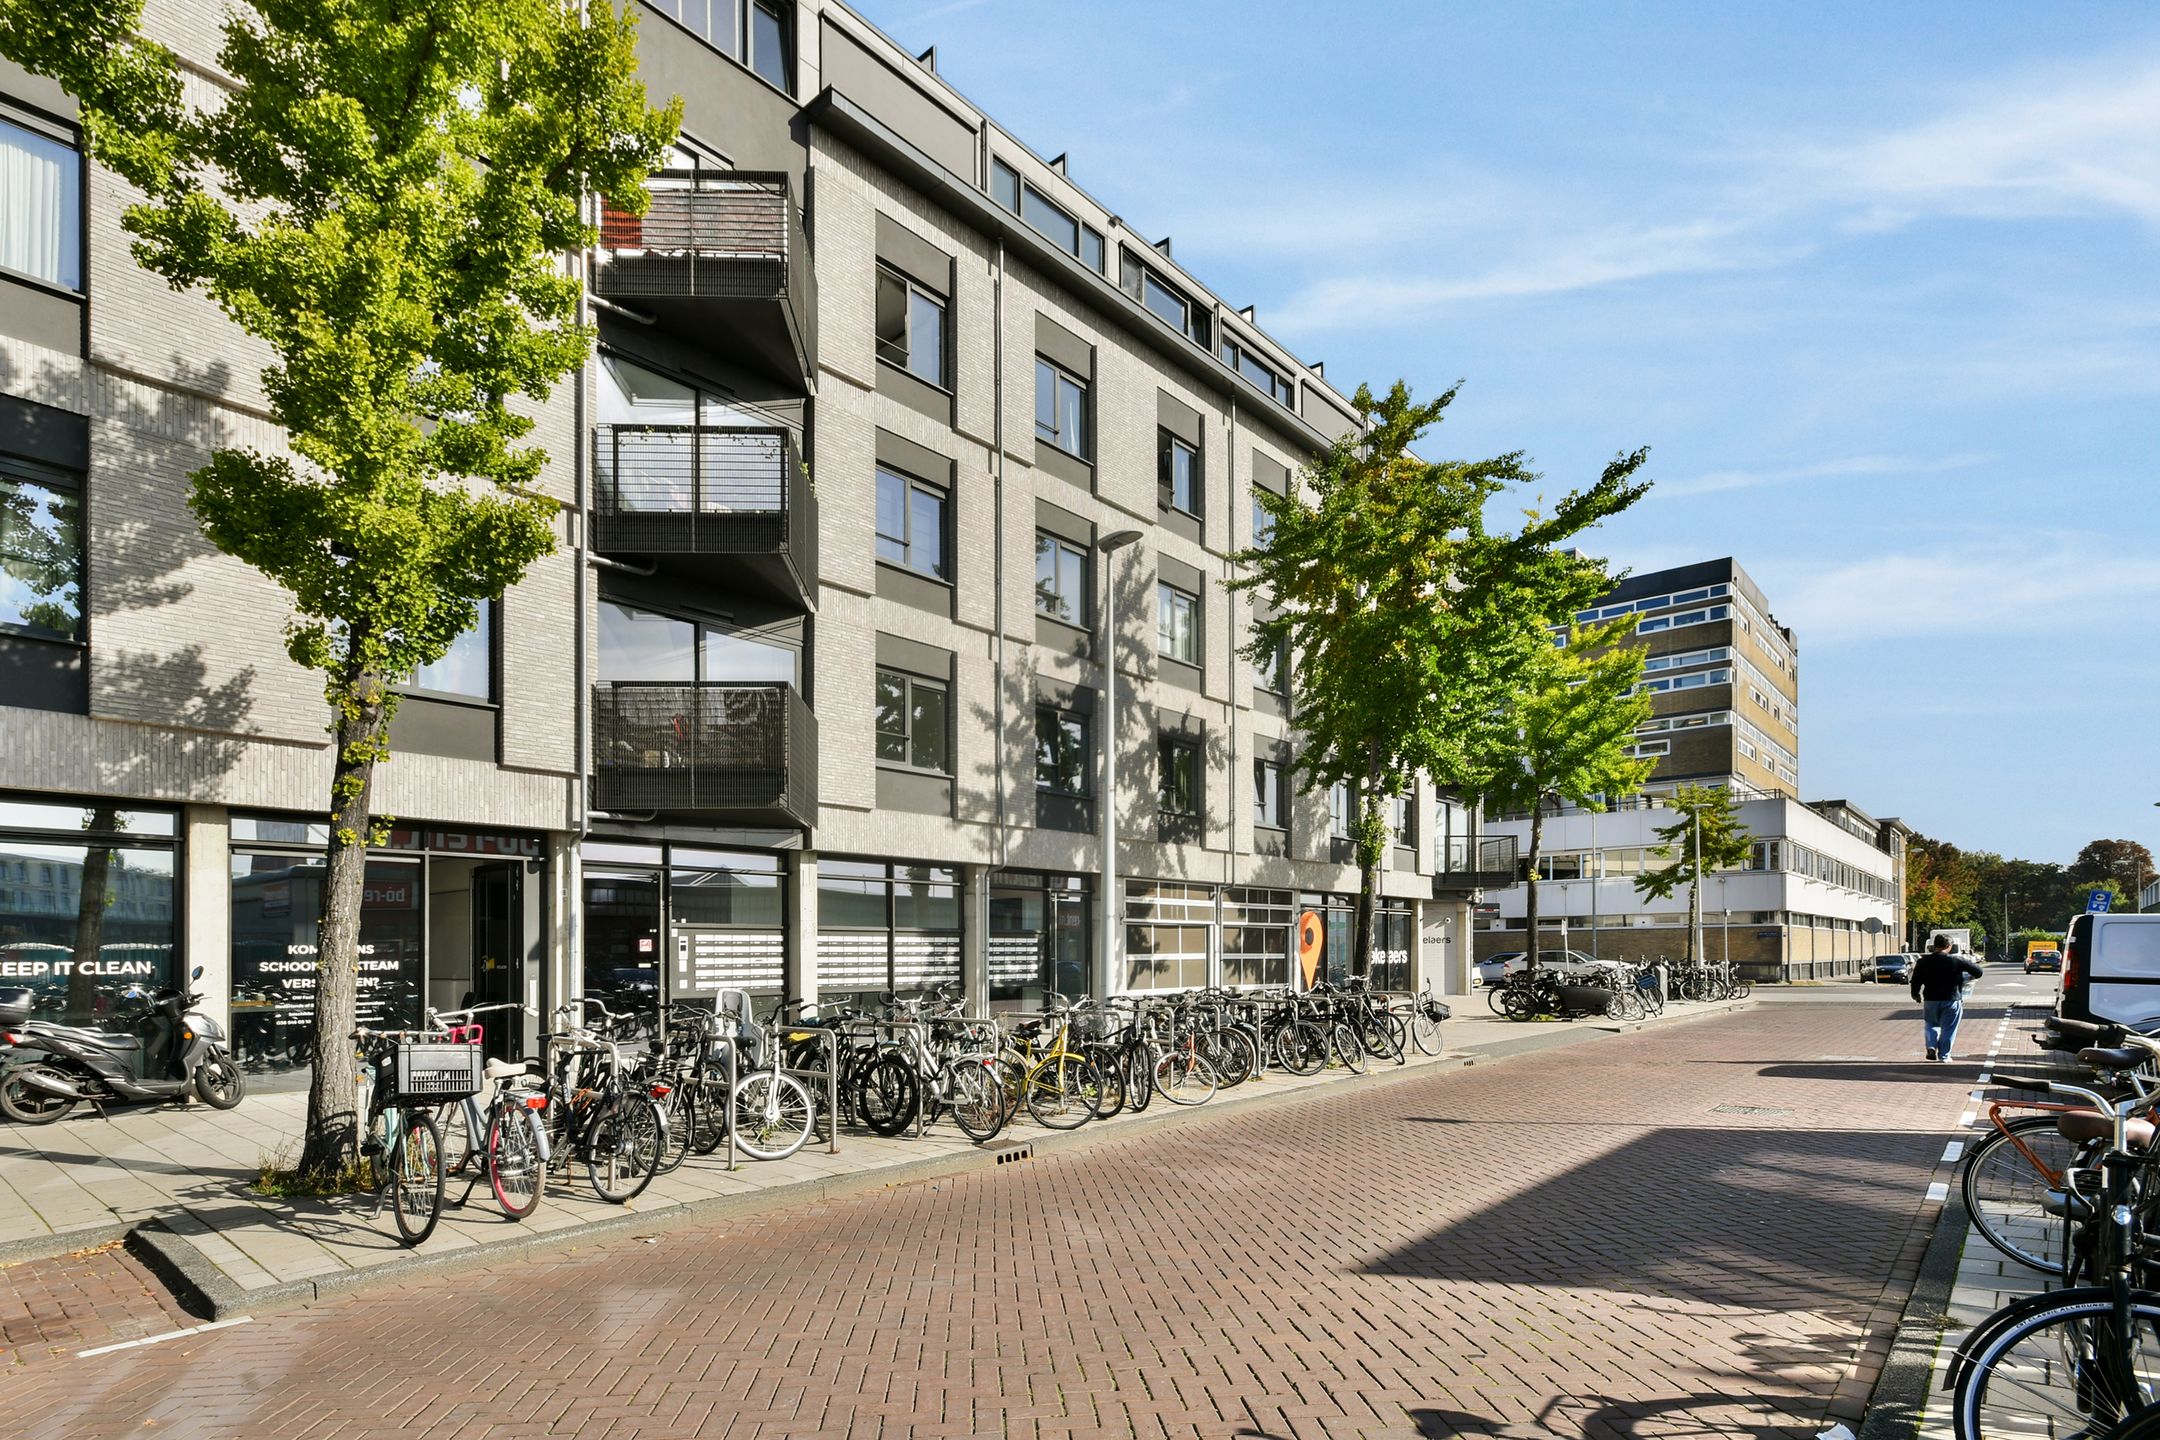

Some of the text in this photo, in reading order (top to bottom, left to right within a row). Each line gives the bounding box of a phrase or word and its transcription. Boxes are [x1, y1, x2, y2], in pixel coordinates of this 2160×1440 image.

[356, 944, 375, 954] NS
[0, 960, 151, 976] EEP IT CLEAN
[2061, 1303, 2104, 1311] ALLROUND
